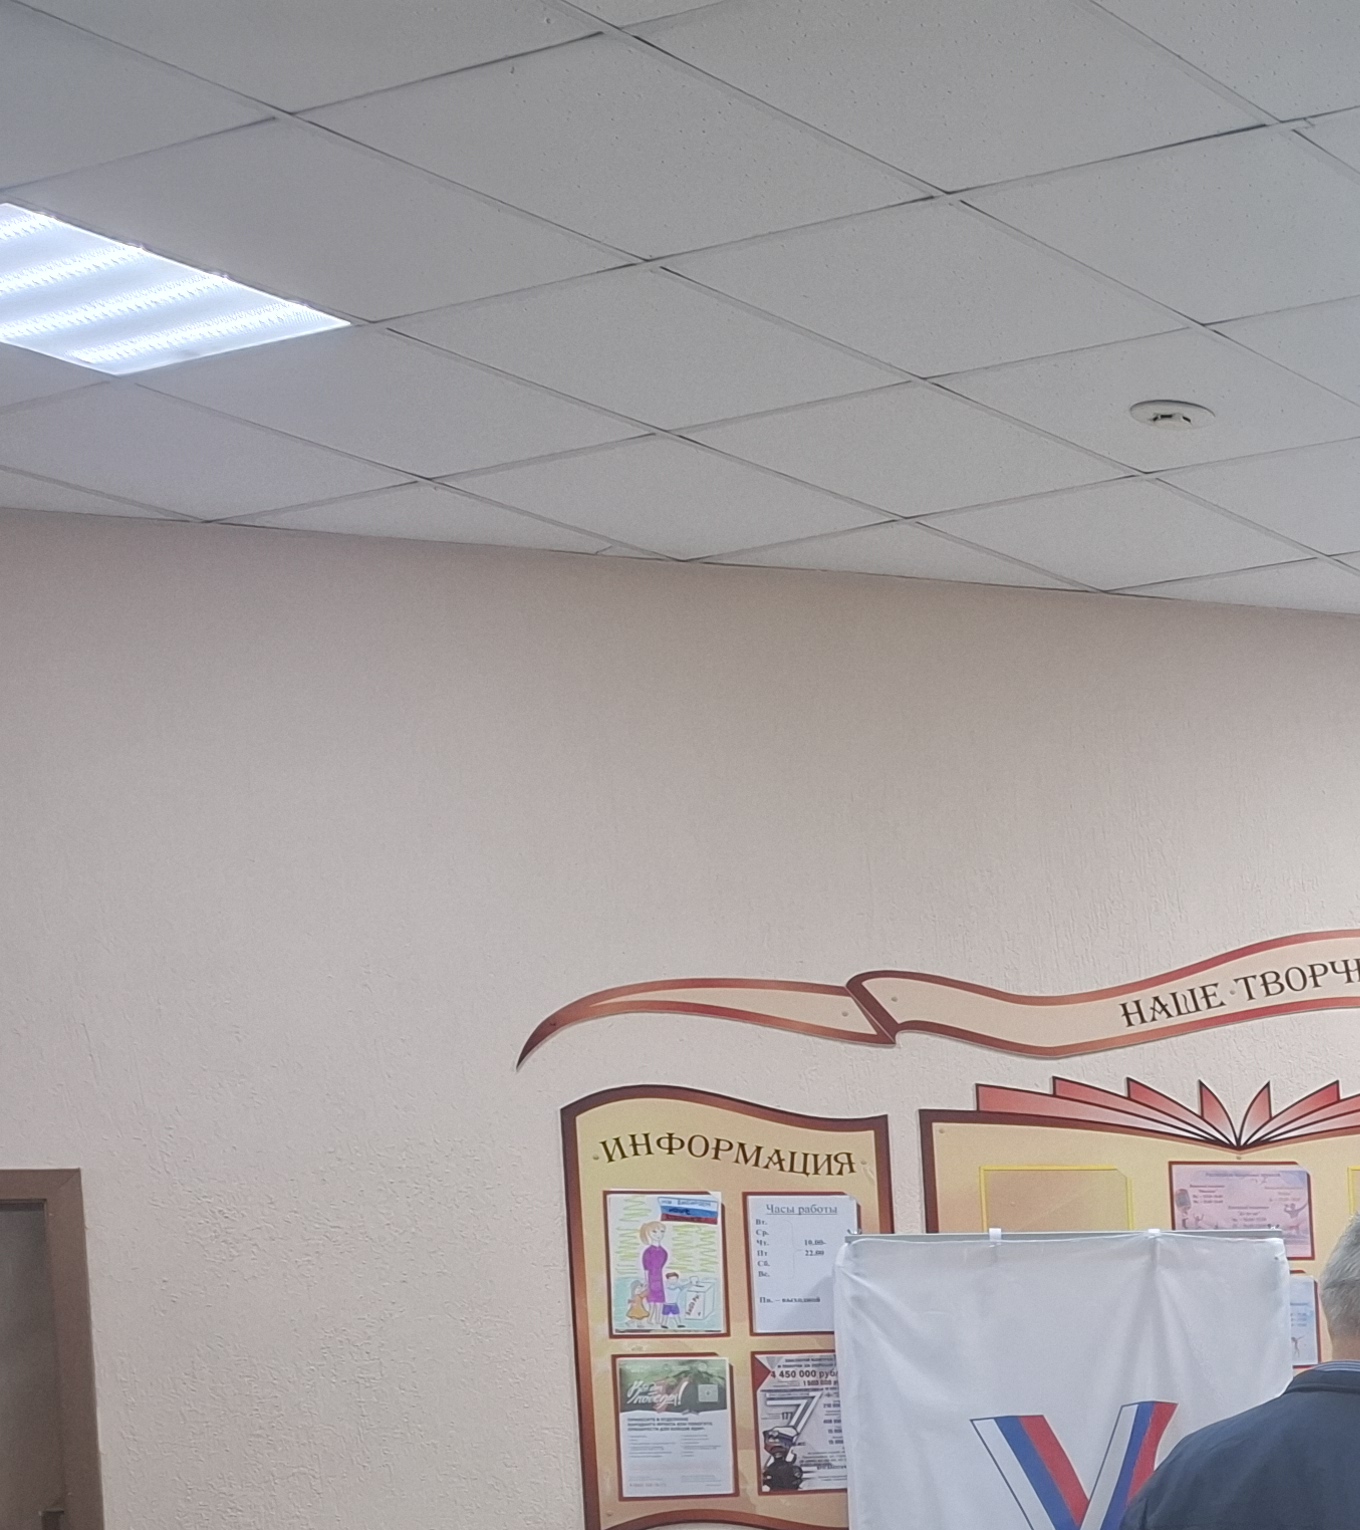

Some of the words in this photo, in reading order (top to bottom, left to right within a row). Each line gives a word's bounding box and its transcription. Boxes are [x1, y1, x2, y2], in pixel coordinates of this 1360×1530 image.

[1119, 983, 1226, 1028] НАШЕ
[600, 1132, 857, 1177] ИНФОРМАЦИЯ
[766, 1204, 795, 1214] Часы
[798, 1204, 838, 1216] работы
